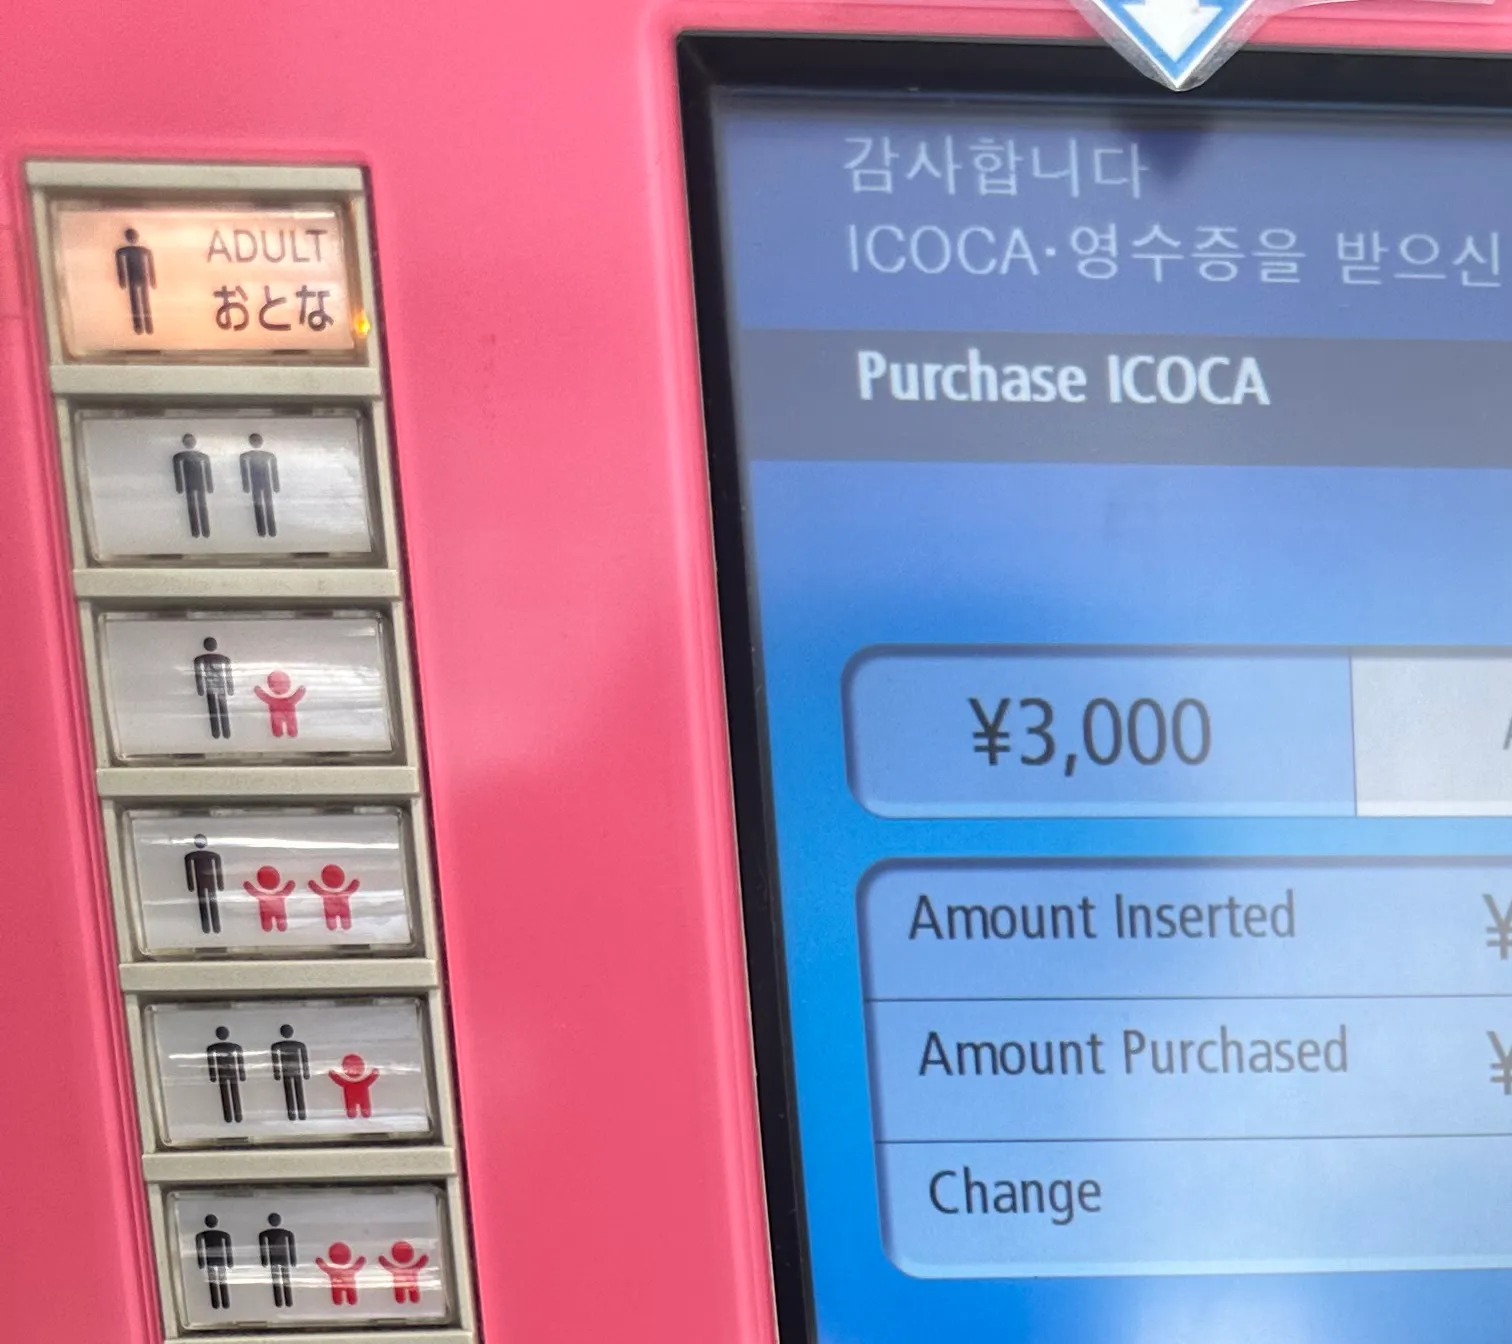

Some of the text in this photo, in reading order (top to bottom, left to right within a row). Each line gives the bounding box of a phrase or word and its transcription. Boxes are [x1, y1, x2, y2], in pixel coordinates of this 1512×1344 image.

[842, 134, 1150, 199] 감사합니다
[207, 229, 328, 264] ADULT
[1337, 231, 1501, 288] 받으신
[213, 284, 334, 332] おとな
[857, 347, 1271, 406] Purchase ICOCA
[968, 696, 1213, 779] ¥3,000
[908, 894, 1097, 941] Amount
[1115, 890, 1297, 939] Inserted
[918, 1031, 1105, 1078] Amount
[1122, 1025, 1350, 1076] Purchased
[929, 1166, 1101, 1226] Change
